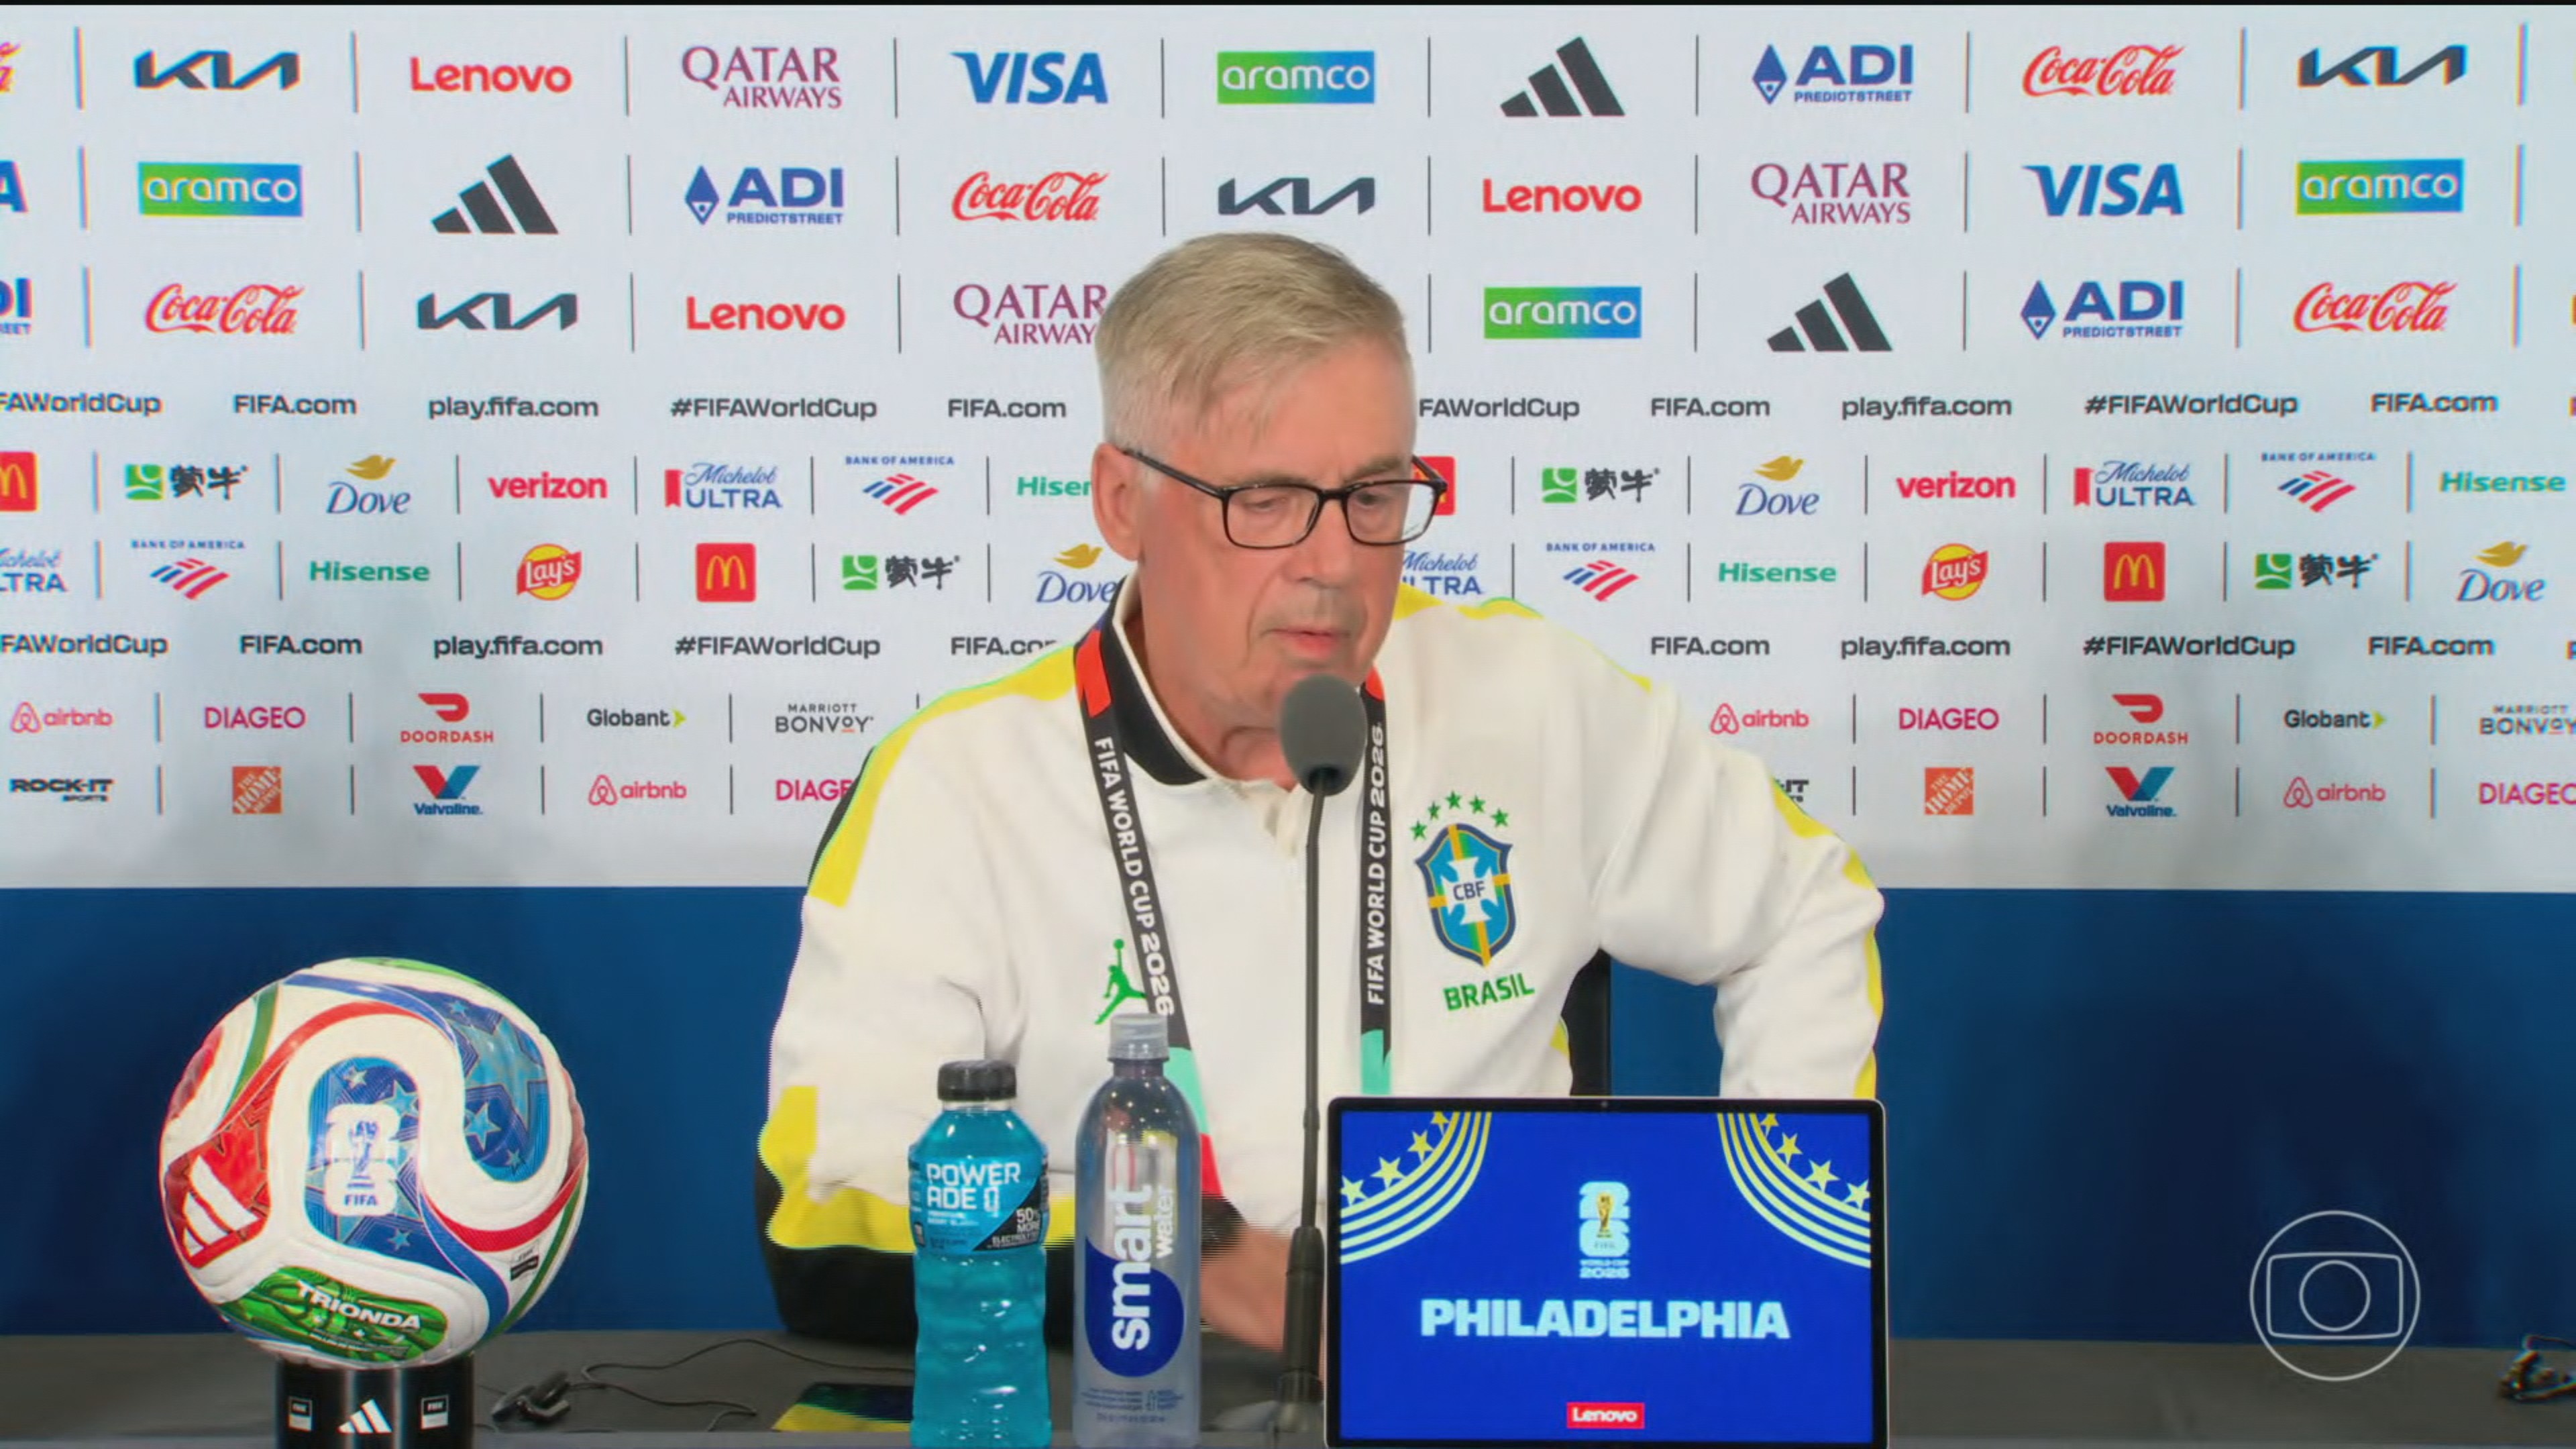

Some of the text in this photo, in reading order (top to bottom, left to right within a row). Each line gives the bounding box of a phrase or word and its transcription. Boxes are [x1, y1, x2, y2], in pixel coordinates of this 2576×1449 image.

[411, 57, 572, 93] Lenovo
[682, 46, 840, 91] QATAR
[1796, 45, 1913, 86] ADI
[2023, 45, 2184, 97] Coca-Cola
[952, 52, 1108, 105] VISA
[1221, 64, 1371, 93] aramco
[722, 87, 842, 109] AIRWAYS
[1794, 90, 1912, 102] PREDICTSTREET
[144, 176, 297, 204] aramco
[729, 168, 843, 207] ADI
[952, 172, 1107, 221] Coca-Cola
[1483, 179, 1642, 213] Lenovo
[1751, 162, 1908, 208] QATAR
[2024, 164, 2183, 217] VISA
[2302, 173, 2459, 200] aramco
[727, 213, 843, 224] PREDICTSTREET
[1790, 204, 1912, 225] AIRWAYS
[144, 283, 302, 333] Coca-Cola
[953, 284, 1107, 327] QATAR
[1488, 299, 1638, 326] aramco
[2064, 281, 2183, 321] ADI
[2294, 282, 2456, 332] Coca-Cola
[687, 297, 846, 331] Lenovo
[994, 323, 1096, 345] AIRWAY
[2063, 325, 2182, 337] PREDICTSTREET
[234, 395, 356, 415] FIFA.com
[429, 396, 598, 420] play.fifa.com
[671, 398, 877, 421] #FIFAWorldCup
[949, 399, 1066, 417] FIFA.com
[1419, 398, 1580, 421] FAWorldCup
[1652, 398, 1770, 417] FIFA.com
[1842, 396, 2012, 420] play.fifa.com
[2084, 394, 2298, 417] #FIFAWorldCup
[2371, 393, 2498, 412] FIFA.com
[845, 455, 954, 465] BANK OF AMERICA
[2261, 452, 2375, 462] BANK OF AMERICA
[684, 463, 777, 484] Michelob
[2093, 461, 2190, 483] Michelob
[2439, 472, 2566, 492] Hisense
[488, 472, 607, 498] verizon
[1896, 475, 2016, 498] verizon
[2094, 487, 2194, 506] ULTRA
[327, 482, 411, 514] Dove
[686, 488, 782, 508] ULTRA
[1736, 482, 1819, 515] Dove
[131, 540, 245, 549] BANK OF AMERICA
[1546, 543, 1655, 551] BANK OF AMERICA
[310, 561, 430, 582] Hisense
[525, 555, 575, 589] Lay's
[1719, 563, 1836, 582] Hisense
[1932, 555, 1982, 589] Lay's
[0, 574, 66, 593] TRA
[1036, 570, 1116, 602] Dove
[1402, 576, 1483, 596] TRA
[2457, 568, 2544, 602] Dove
[0, 635, 168, 657] FAWorldCup
[241, 635, 362, 654] FIFA.com
[434, 635, 602, 659] play.fifa.com
[675, 636, 880, 659] #FIFAWorldCup
[1652, 637, 1770, 655] FIFA.com
[1841, 636, 2010, 659] play.fifa.com
[2084, 636, 2295, 659] #FIFAWorldCup
[2369, 637, 2493, 655] FIFA.com
[44, 708, 113, 726] airbnb
[205, 706, 306, 729] DIAGEO
[586, 708, 669, 727] Globant
[788, 704, 858, 712] MARRIOTT
[1743, 710, 1809, 729] airbnb
[1899, 708, 1999, 730] DIAGEO
[2284, 708, 2370, 729] Globant
[775, 715, 869, 733] BONVOY
[400, 731, 494, 743] DOORDASH
[2094, 732, 2188, 745] DOORDASH
[11, 779, 113, 793] ROCK-IT
[621, 781, 687, 800] airbnb
[775, 780, 852, 801] DIAGE
[2316, 784, 2385, 802] airbnb
[1095, 736, 1175, 1016] FIFA WORLD CUP 2026
[1367, 726, 1387, 1005] FIFA WORLD CUP 2026
[1452, 881, 1485, 901] CBF
[1443, 973, 1535, 1011] BRASIL
[926, 1163, 1021, 1186] POWER
[343, 1193, 378, 1206] FIFA
[927, 1186, 977, 1210] ADE
[1155, 1187, 1173, 1259] water
[1110, 1183, 1152, 1351] smart
[1579, 1267, 1630, 1279] 2026
[297, 1281, 421, 1331] TRIONDA
[1420, 1299, 1790, 1339] PHILADELPHIA
[1572, 1408, 1638, 1423] Lenovo
